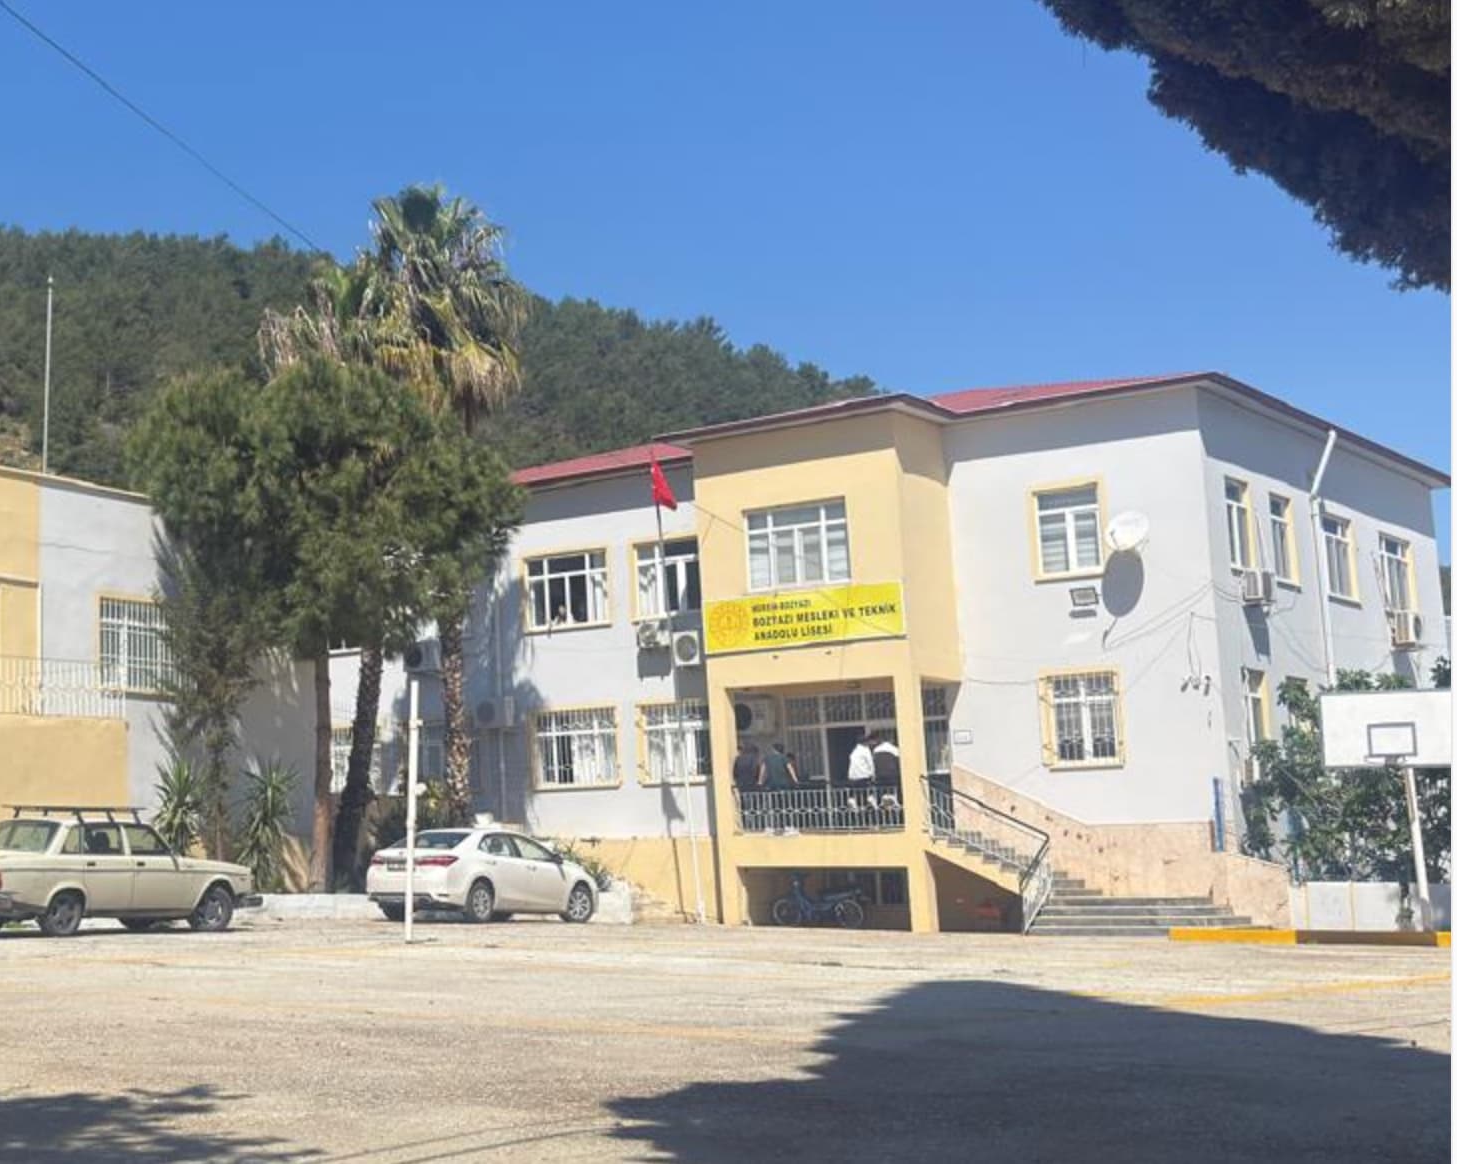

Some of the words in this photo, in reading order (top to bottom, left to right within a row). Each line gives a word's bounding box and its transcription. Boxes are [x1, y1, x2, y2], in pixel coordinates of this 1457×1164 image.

[753, 613, 793, 627] BOZYAZI
[843, 607, 855, 618] VE
[754, 627, 798, 641] ANADOLU
